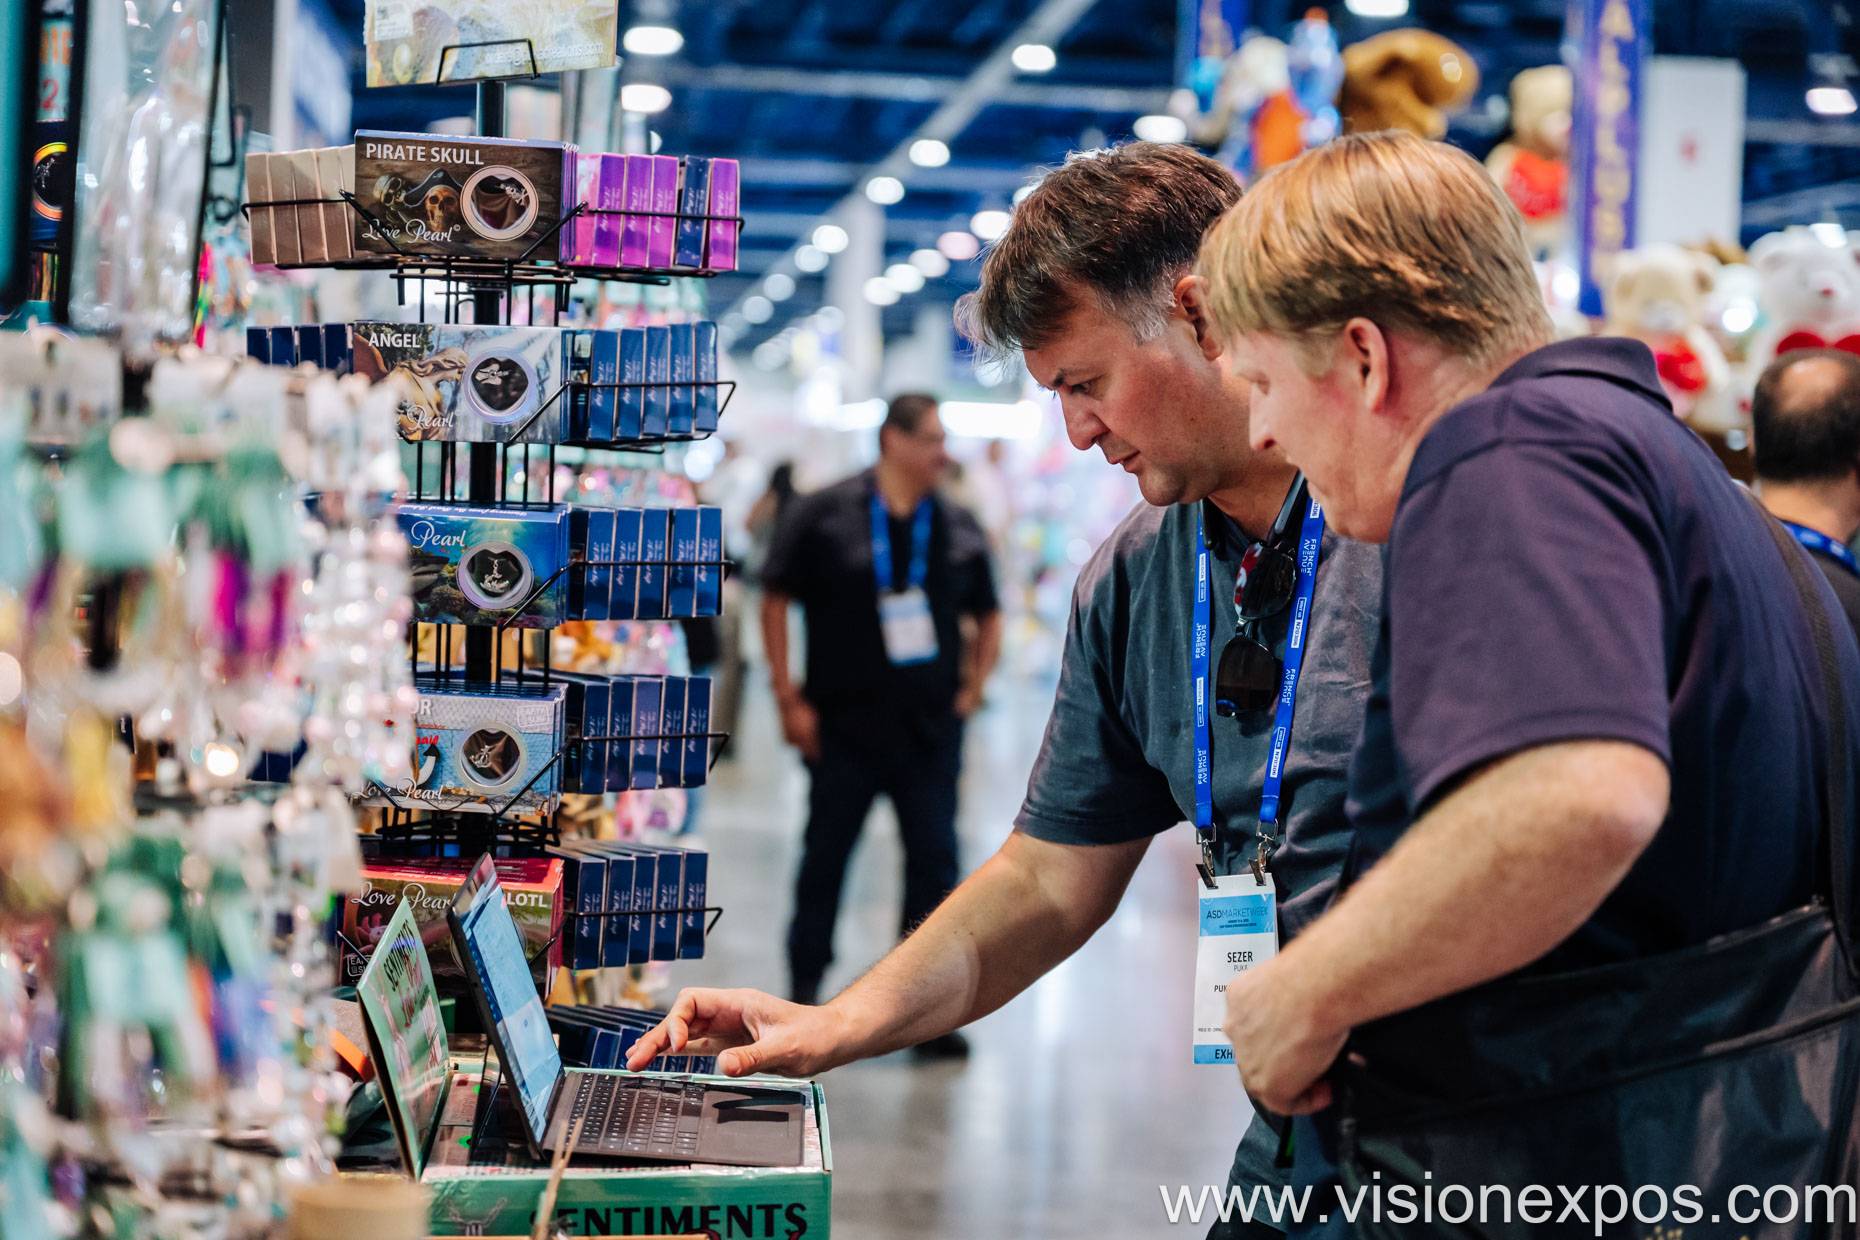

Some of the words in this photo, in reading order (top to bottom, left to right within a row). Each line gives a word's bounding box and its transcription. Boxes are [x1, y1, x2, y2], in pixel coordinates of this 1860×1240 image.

[365, 142, 426, 162] PIRATE
[430, 147, 484, 165] SKULL
[405, 218, 452, 244] Pearl
[368, 332, 421, 348] ANGEL
[407, 405, 453, 431] Pearl
[411, 520, 467, 549] Pearl
[1300, 538, 1310, 574] AVENUE
[1306, 538, 1317, 575] FRENCH
[397, 776, 443, 802] Pearl
[351, 881, 395, 907] Love
[506, 893, 548, 908] LOTL
[1227, 951, 1253, 963] SEZER
[1215, 1048, 1233, 1060] EXH
